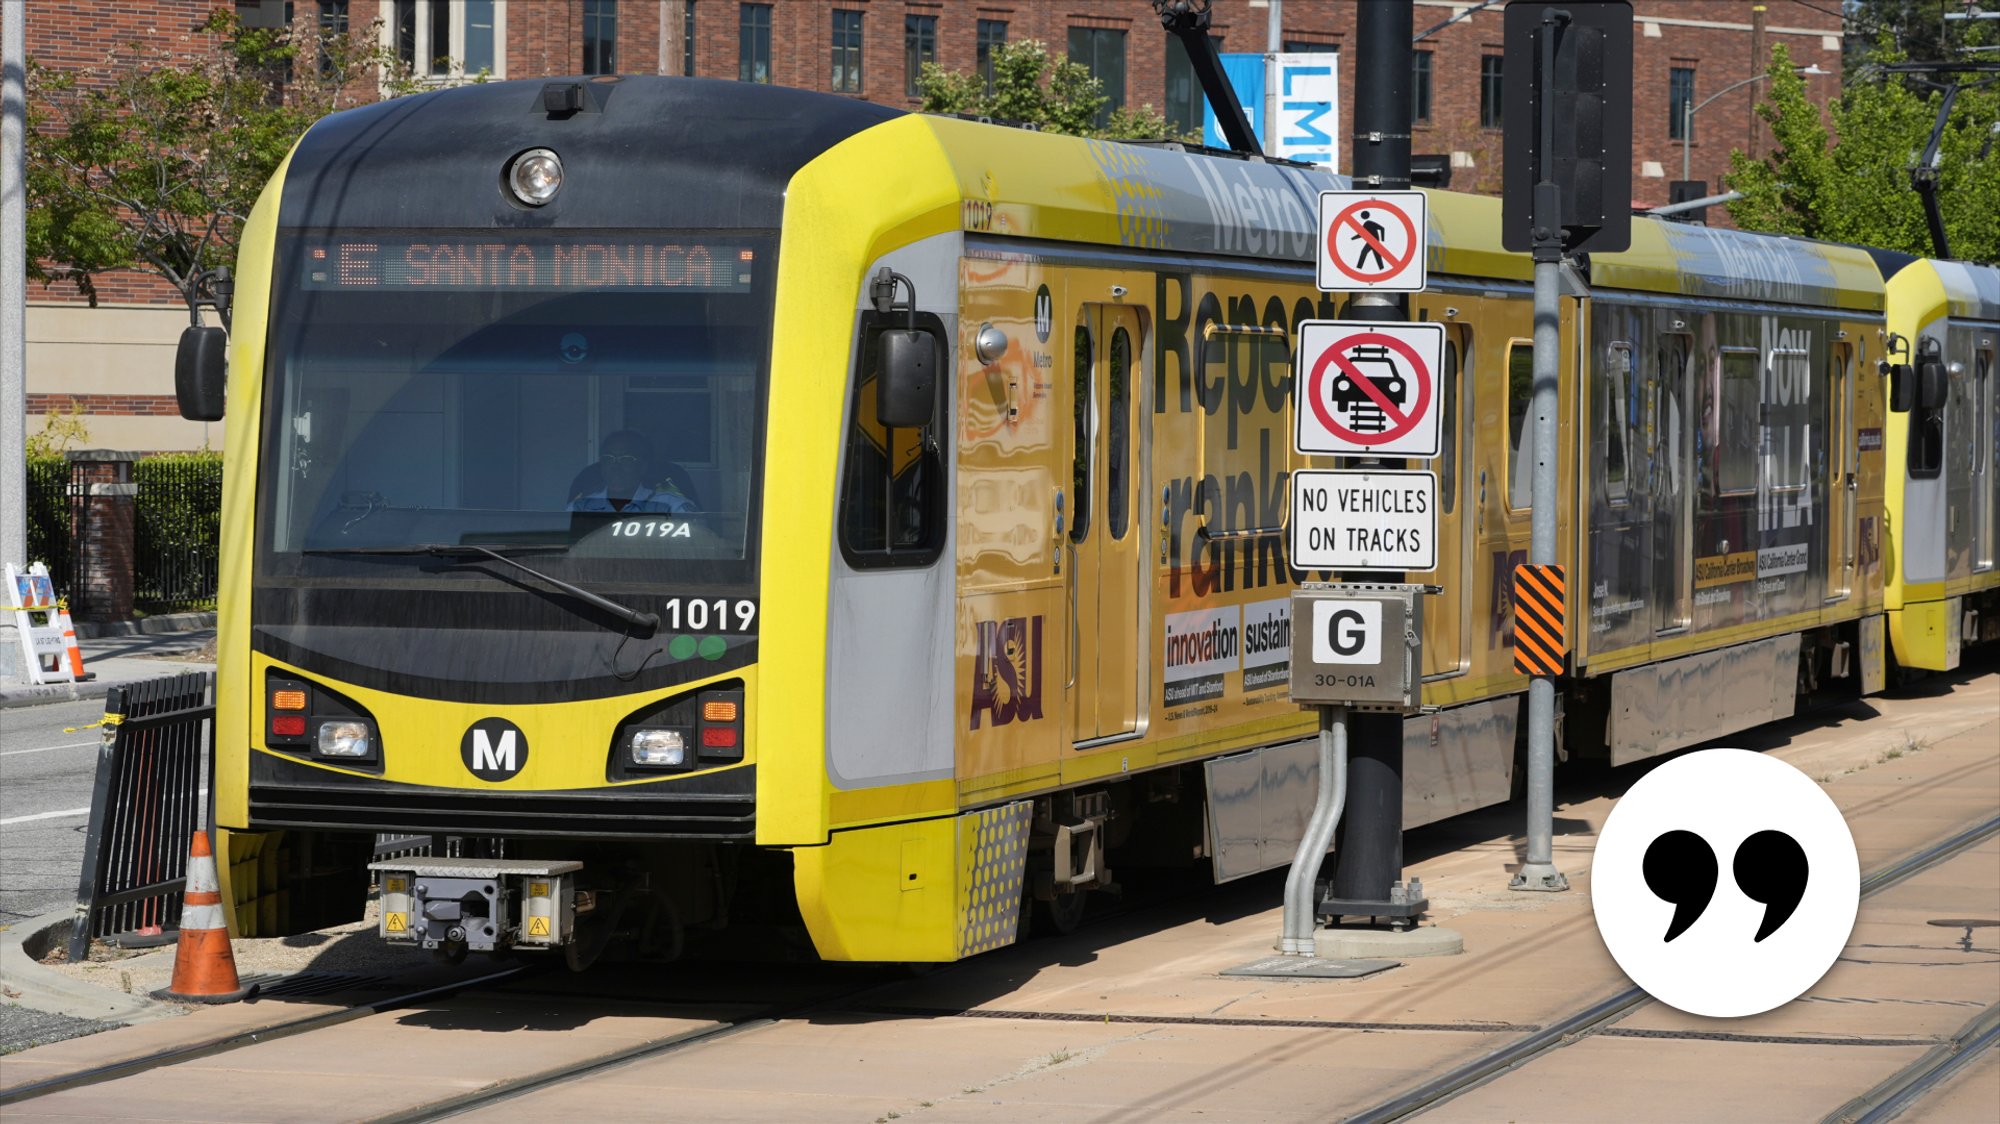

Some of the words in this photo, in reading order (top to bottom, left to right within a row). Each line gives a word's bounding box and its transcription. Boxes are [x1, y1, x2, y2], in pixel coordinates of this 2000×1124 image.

[966, 199, 992, 231] 1019
[1184, 155, 1313, 257] Metro
[341, 243, 378, 286] E
[406, 244, 537, 286] SANTA
[555, 244, 712, 287] MONICA
[1703, 229, 1772, 299] Metro
[1033, 351, 1053, 369] Metro
[1760, 315, 1812, 408] Now
[1303, 488, 1328, 512] NO
[1338, 488, 1427, 514] VEHICLES
[611, 521, 692, 538] 1019A
[1309, 527, 1335, 551] ON
[1346, 528, 1421, 553] TRACKS
[666, 598, 756, 631] 1019
[1328, 609, 1366, 656] G
[1166, 617, 1238, 668] innovation
[970, 615, 1044, 731] ASU
[1315, 674, 1375, 688] 30-01A
[472, 729, 516, 772] M
